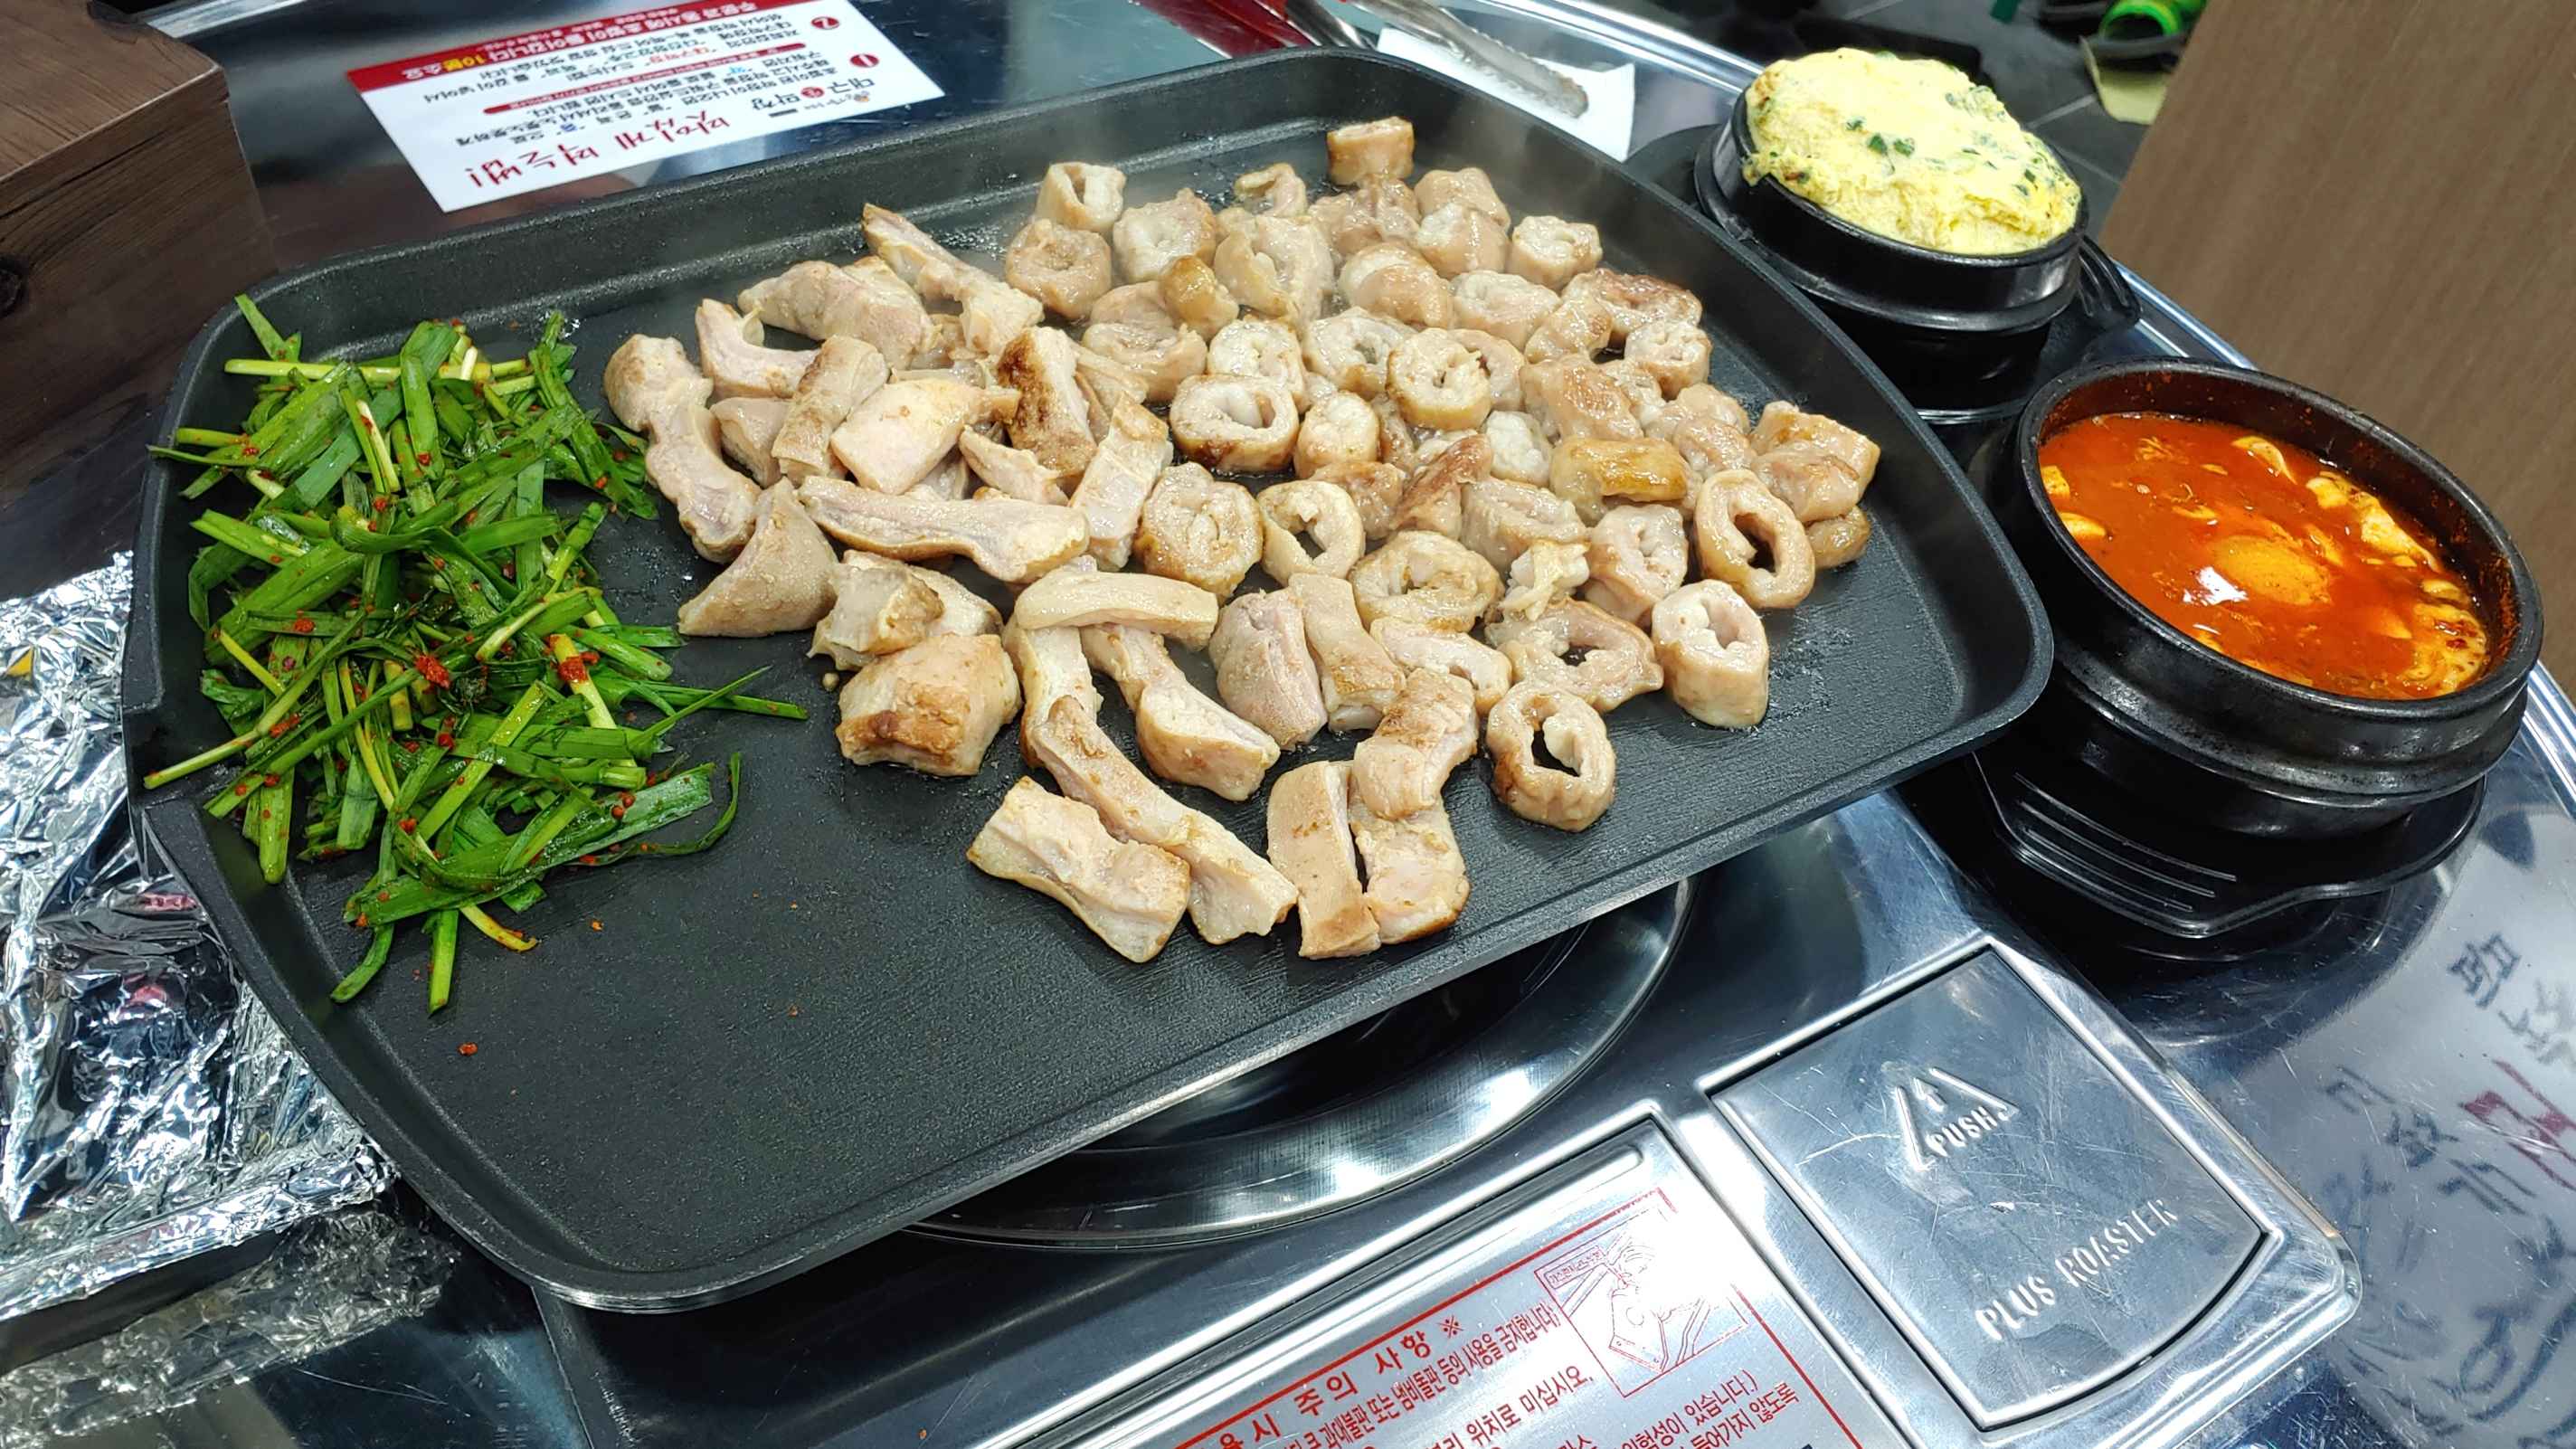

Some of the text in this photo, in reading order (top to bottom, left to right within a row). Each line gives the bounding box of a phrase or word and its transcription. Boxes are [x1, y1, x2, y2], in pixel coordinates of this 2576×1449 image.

[464, 109, 729, 187] 맛있게 먹는법!
[1924, 1105, 1995, 1158] PUSH
[1975, 1198, 2177, 1340] PLUS ROASTER
[1367, 1391, 1401, 1424] 또는
[1436, 1350, 1472, 1387] 등의
[1461, 1331, 1505, 1371] 사용을
[1374, 1331, 1432, 1376] 사항
[1683, 1367, 1758, 1426] 있습니다.)
[1748, 1379, 1801, 1425] 않도록
[1466, 1403, 1521, 1447] 위치로
